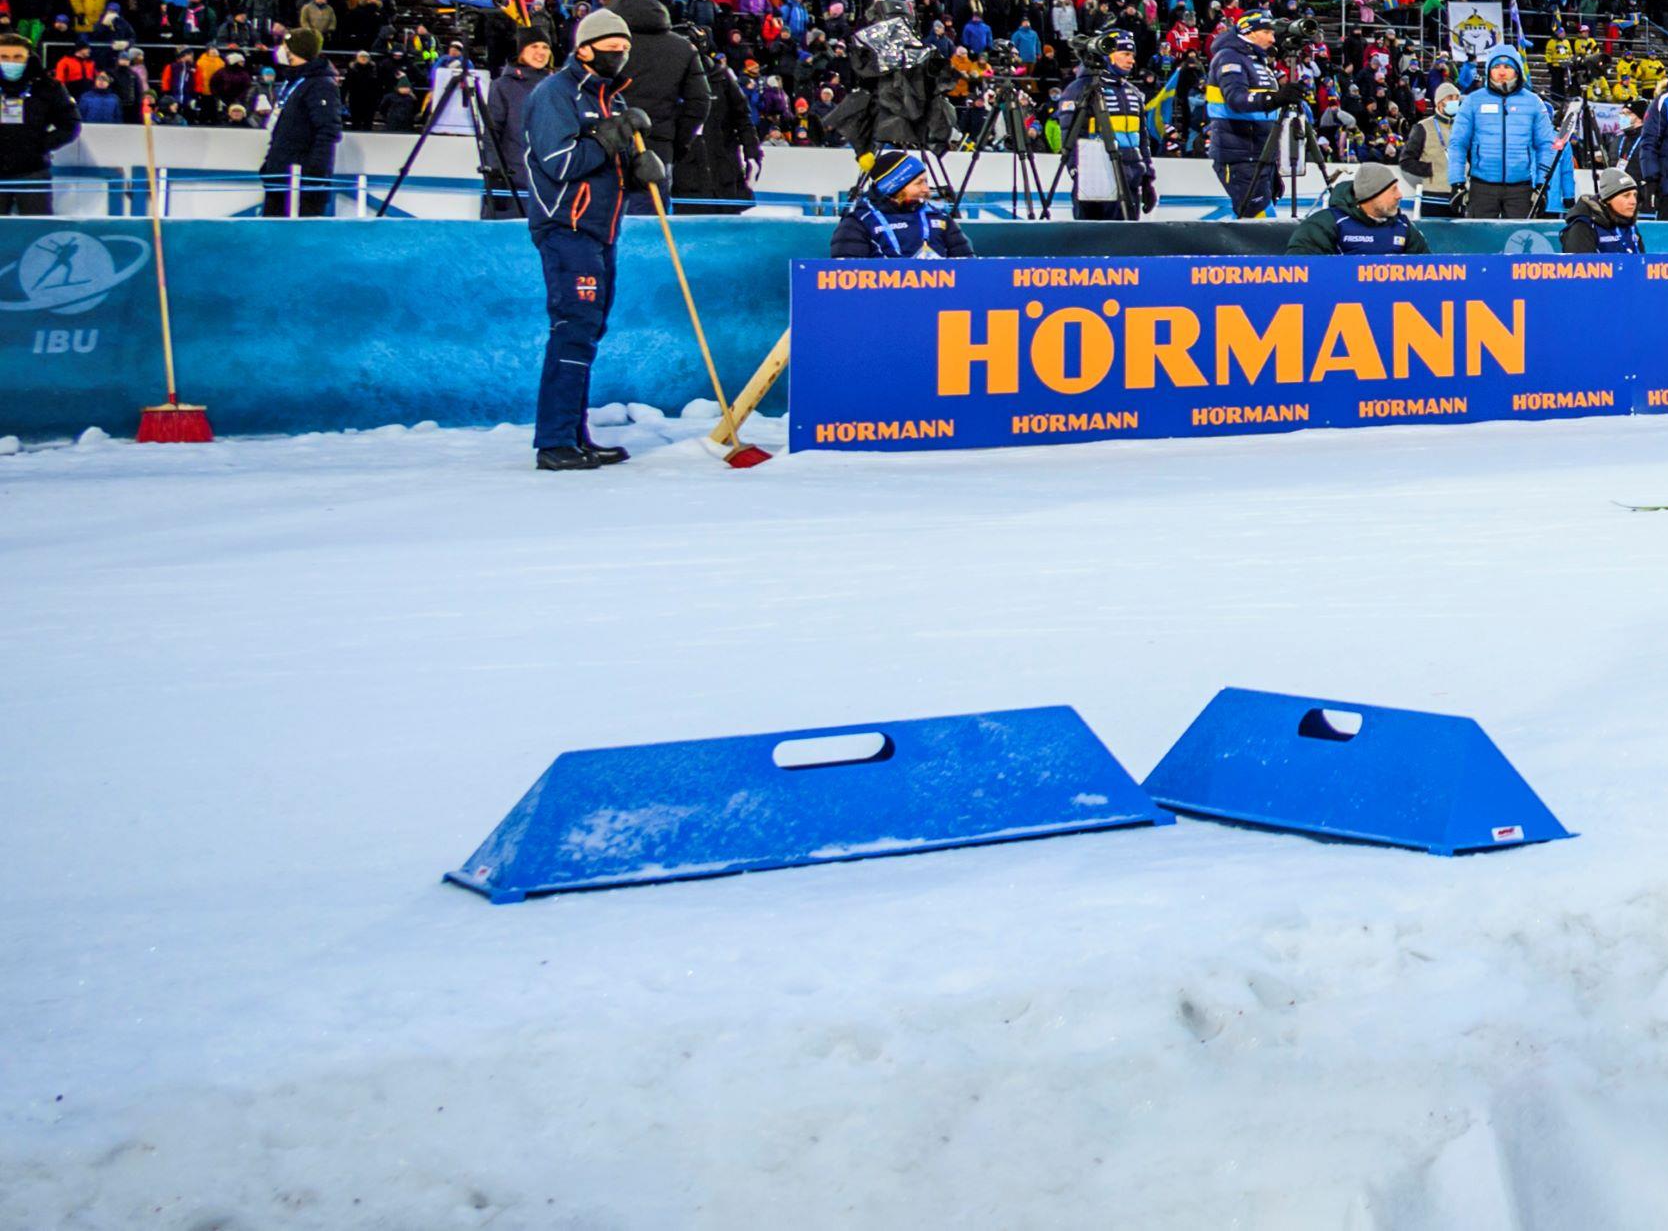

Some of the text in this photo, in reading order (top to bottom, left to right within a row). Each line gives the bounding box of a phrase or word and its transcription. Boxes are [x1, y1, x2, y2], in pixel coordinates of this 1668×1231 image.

[817, 262, 1613, 290] HÖRMANN HÖRMANN HÖRMANN HÖRMANN HÖRMANN
[32, 329, 99, 354] IBU
[937, 299, 1525, 396] HÖRMANN
[816, 390, 1614, 443] HÖRMANN HÖRMANN HÖRMANN HÖRMANN HÖRMANN
